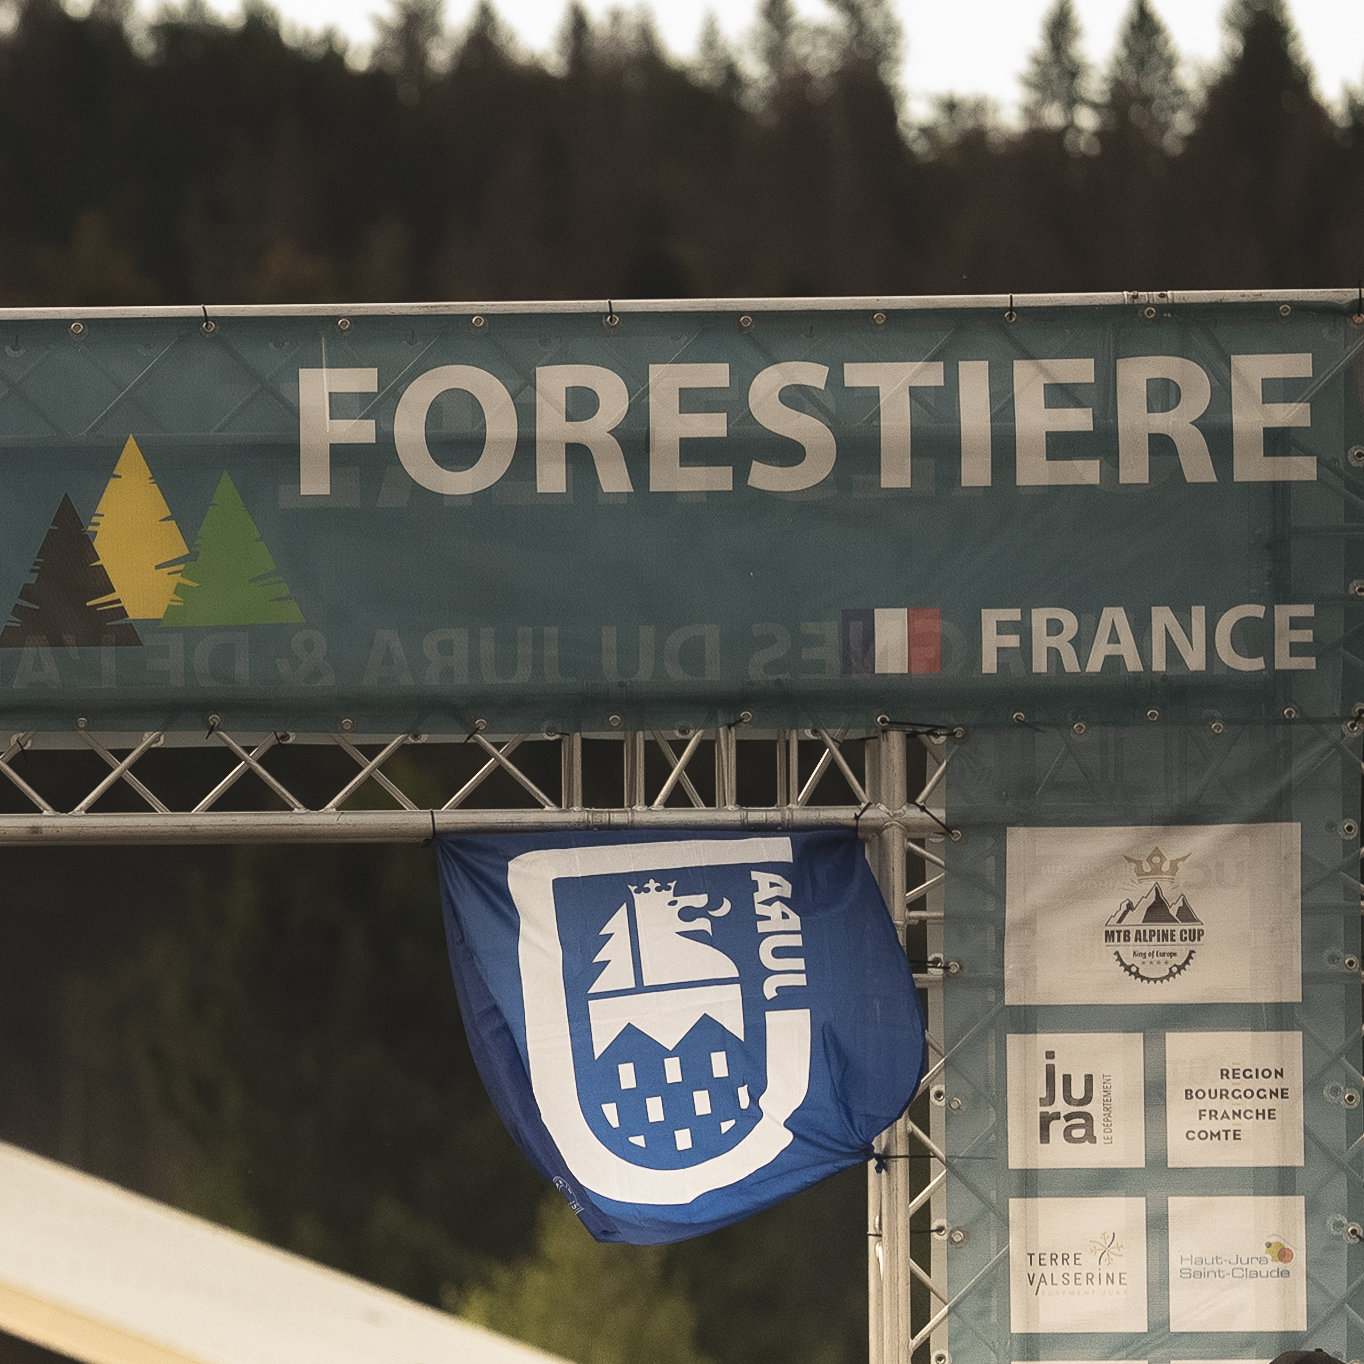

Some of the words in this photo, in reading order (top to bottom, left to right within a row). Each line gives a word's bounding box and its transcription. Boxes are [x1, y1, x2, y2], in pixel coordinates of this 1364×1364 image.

[298, 352, 1318, 498] FORESTIERE
[980, 604, 1318, 676] FRANCE
[1104, 929, 1131, 944] MTB
[1134, 929, 1176, 943] ALPINE
[1179, 928, 1205, 943] CUP
[1219, 1067, 1285, 1080] REGION
[1184, 1087, 1290, 1101] BOURGOGNE
[1198, 1107, 1277, 1121] FRANCHE
[1185, 1129, 1242, 1142] COMTE
[1027, 1252, 1082, 1267] TERRE
[1179, 1253, 1270, 1267] Haut-Jura
[1179, 1267, 1291, 1280] Saint-Claude
